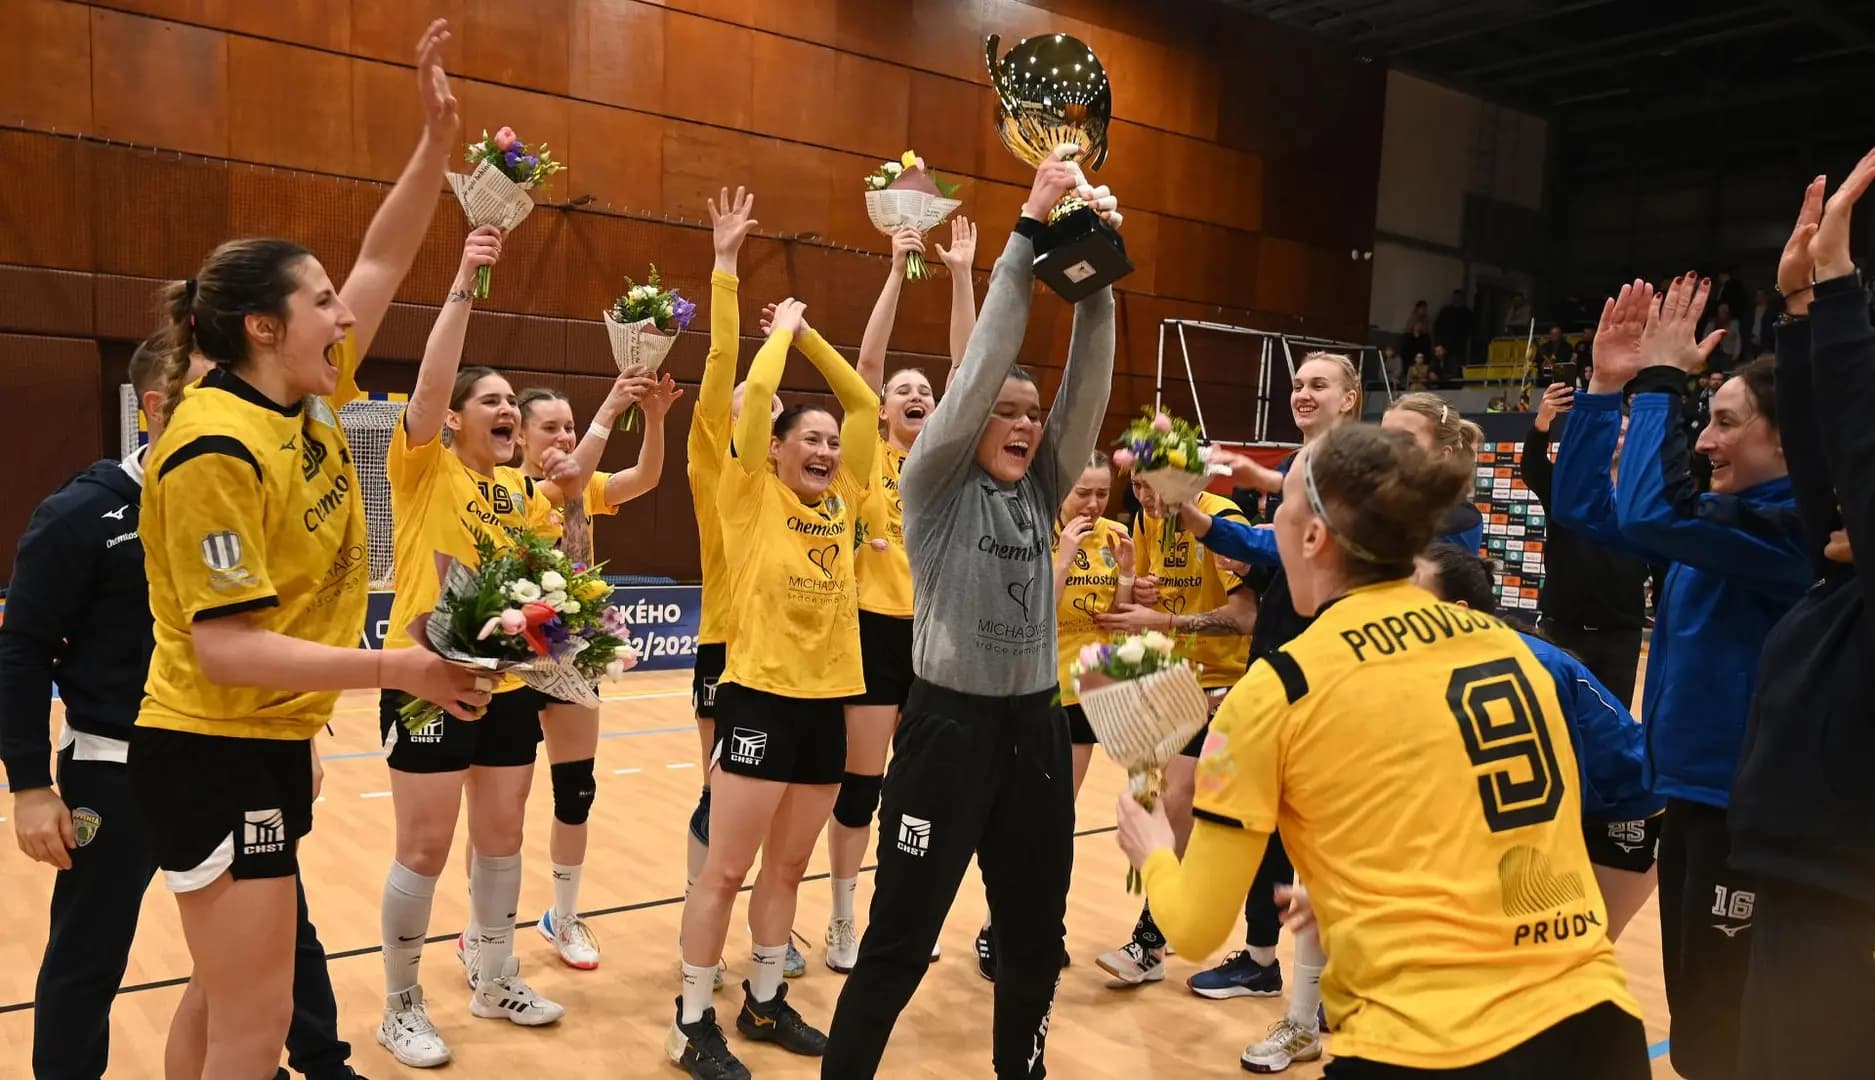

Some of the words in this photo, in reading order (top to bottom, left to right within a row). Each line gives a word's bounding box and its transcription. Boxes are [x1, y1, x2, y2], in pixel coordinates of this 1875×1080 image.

[478, 481, 513, 514] 19
[618, 598, 681, 624] KÉHO
[1446, 657, 1565, 833] 9
[731, 754, 761, 766] CHST
[244, 843, 285, 855] CHST
[897, 841, 928, 857] CHST
[1712, 885, 1755, 920] 16
